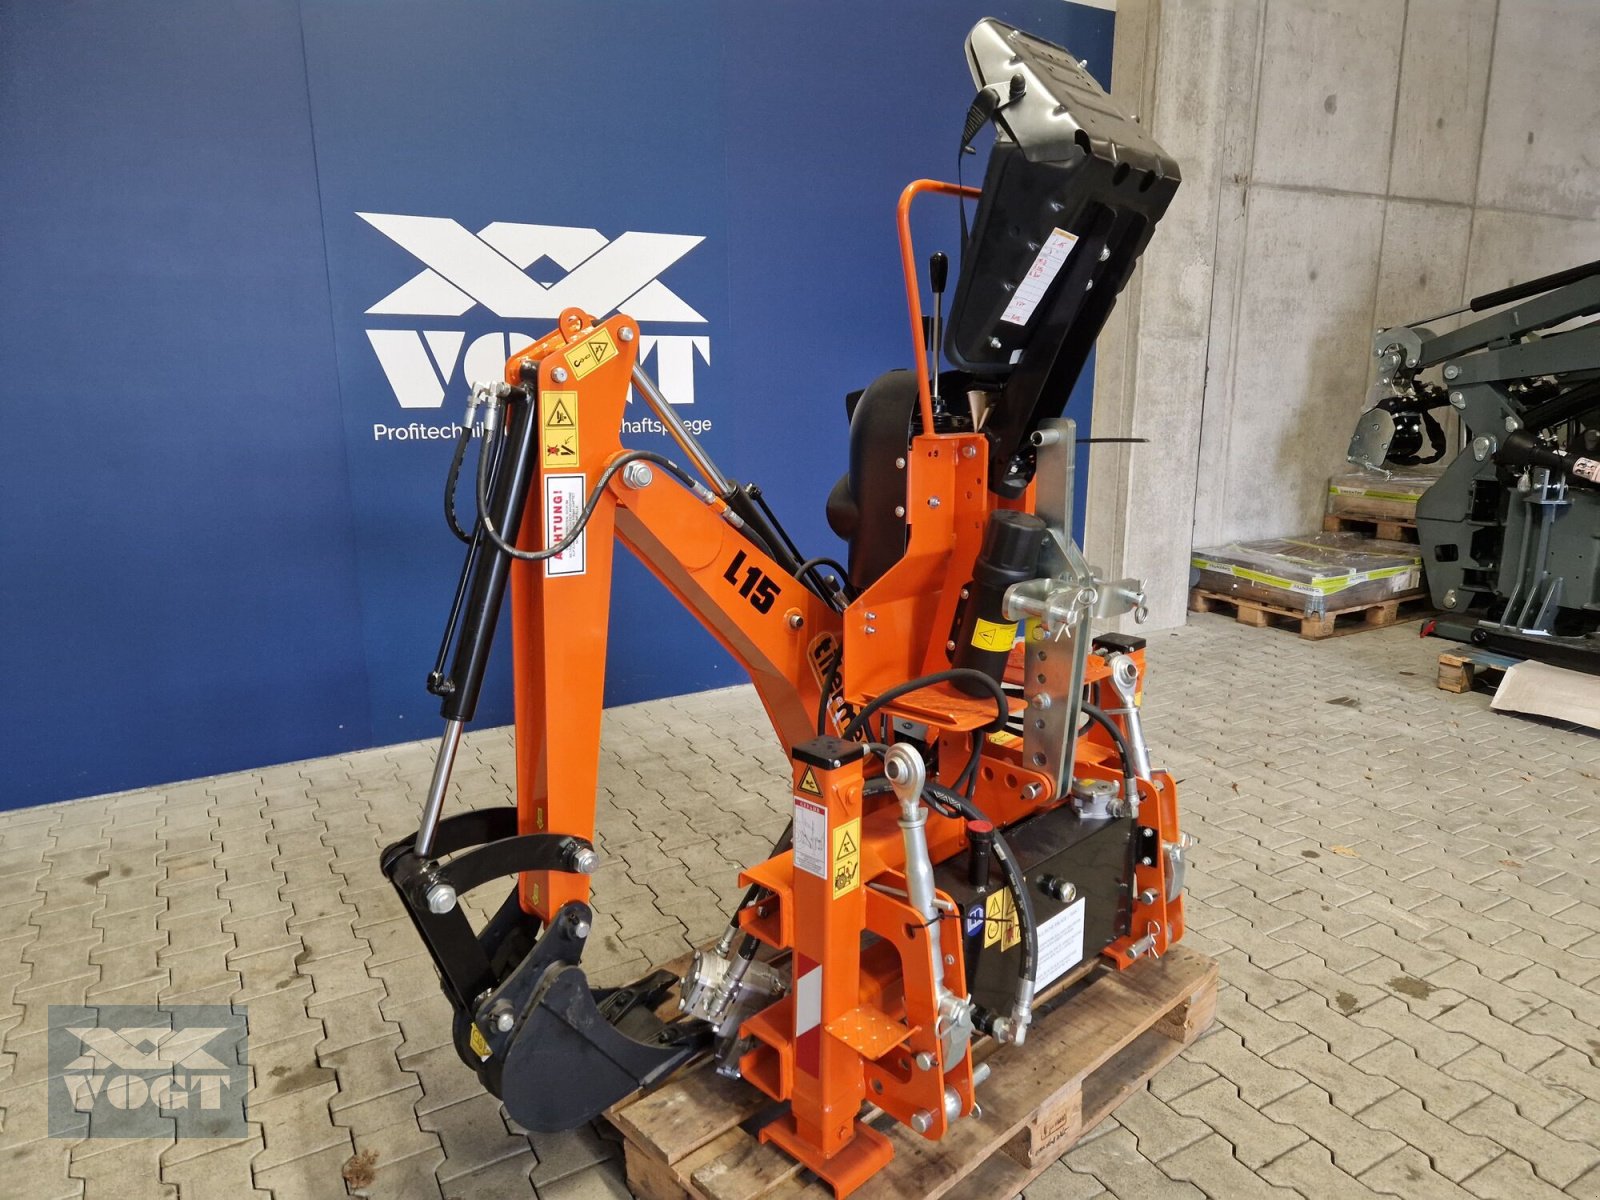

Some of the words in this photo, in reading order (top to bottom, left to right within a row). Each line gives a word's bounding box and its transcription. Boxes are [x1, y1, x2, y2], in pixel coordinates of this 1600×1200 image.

[365, 329, 711, 409] VOT
[553, 490, 563, 560] AHTUNG!
[723, 549, 782, 615] L15
